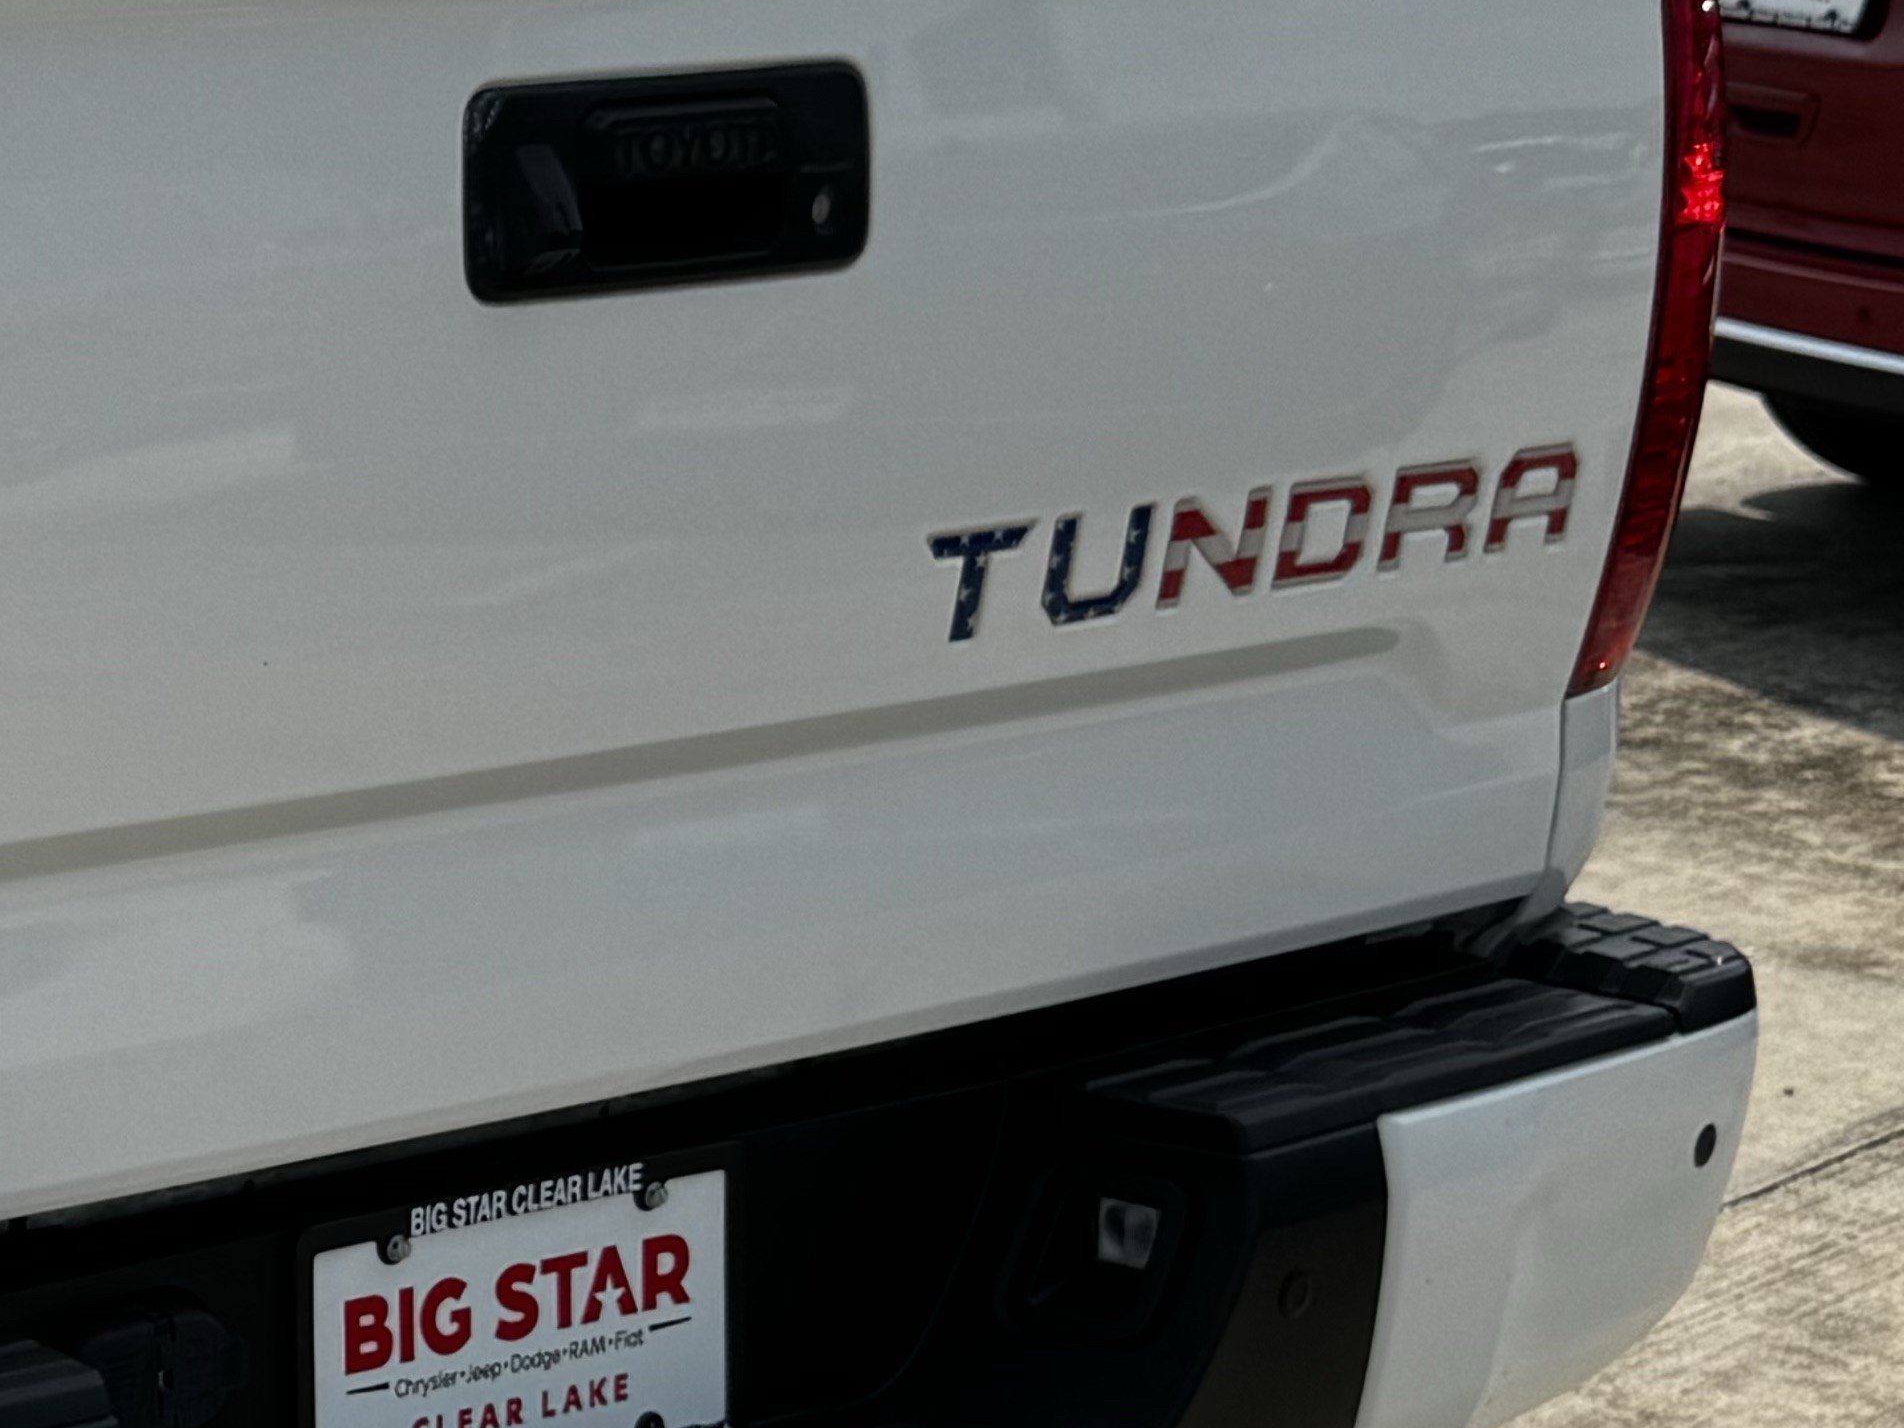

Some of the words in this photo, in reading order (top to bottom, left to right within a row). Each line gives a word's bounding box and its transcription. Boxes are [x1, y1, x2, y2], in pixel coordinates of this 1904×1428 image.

[926, 441, 1579, 643] TUNDRA
[411, 1203, 447, 1237] BIG
[452, 1189, 507, 1226] STAR
[512, 1174, 581, 1214] CLEAR
[588, 1163, 644, 1199] LAKE
[344, 1277, 472, 1376] BIG
[495, 1234, 690, 1342] STAR
[394, 1369, 458, 1398] Chrysler
[511, 1350, 561, 1374] Dodge
[569, 1336, 607, 1360] RAM
[615, 1329, 645, 1350] Fiat
[542, 1373, 629, 1418] LAKE
